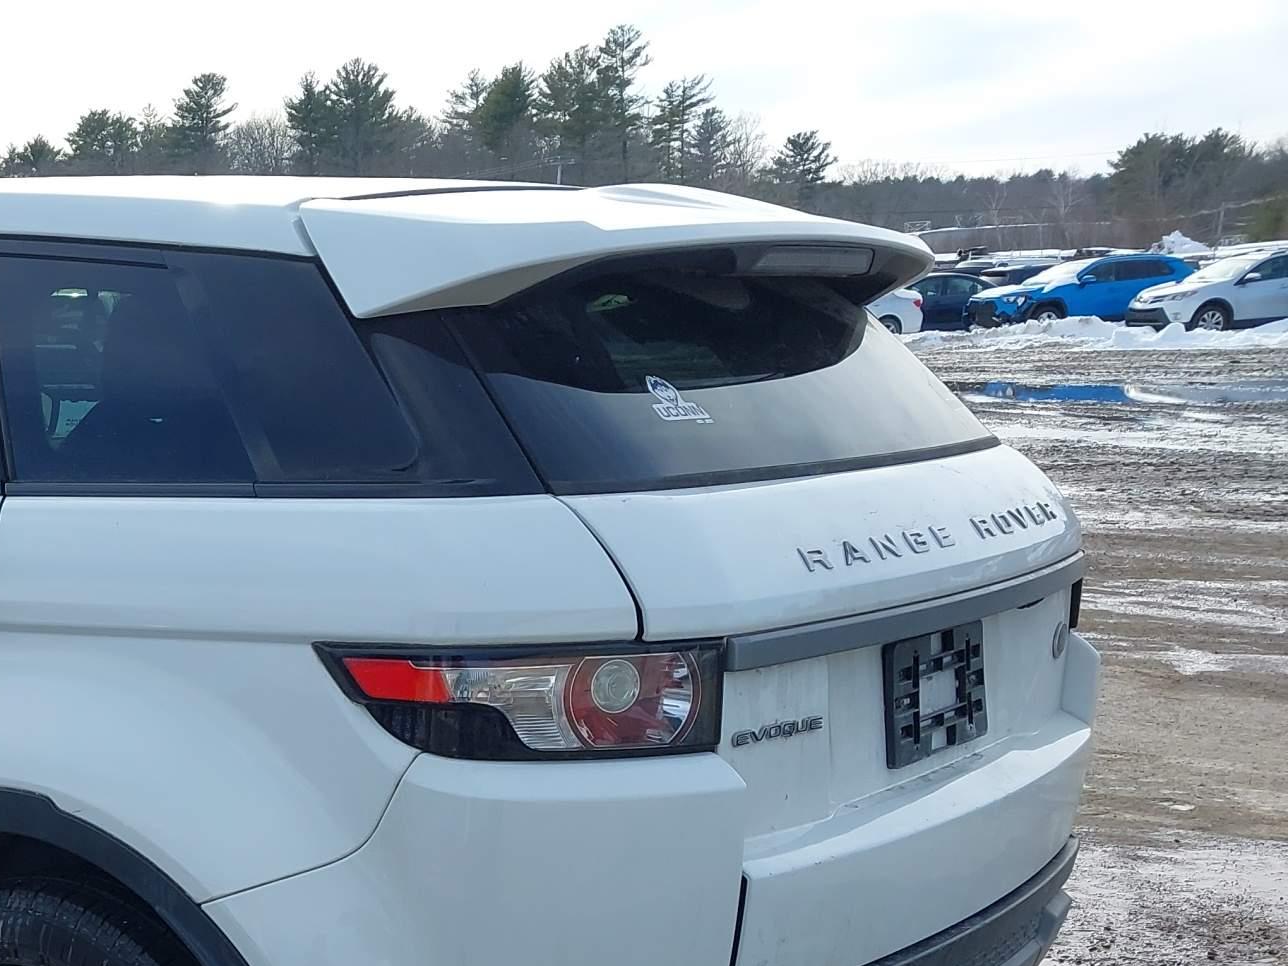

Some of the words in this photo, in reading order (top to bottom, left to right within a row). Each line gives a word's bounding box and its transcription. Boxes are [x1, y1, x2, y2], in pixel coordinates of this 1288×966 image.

[655, 405, 706, 418] UCONN
[796, 525, 957, 573] RANGE
[969, 501, 1058, 540] ROVER
[731, 715, 824, 748] EVOQUE
